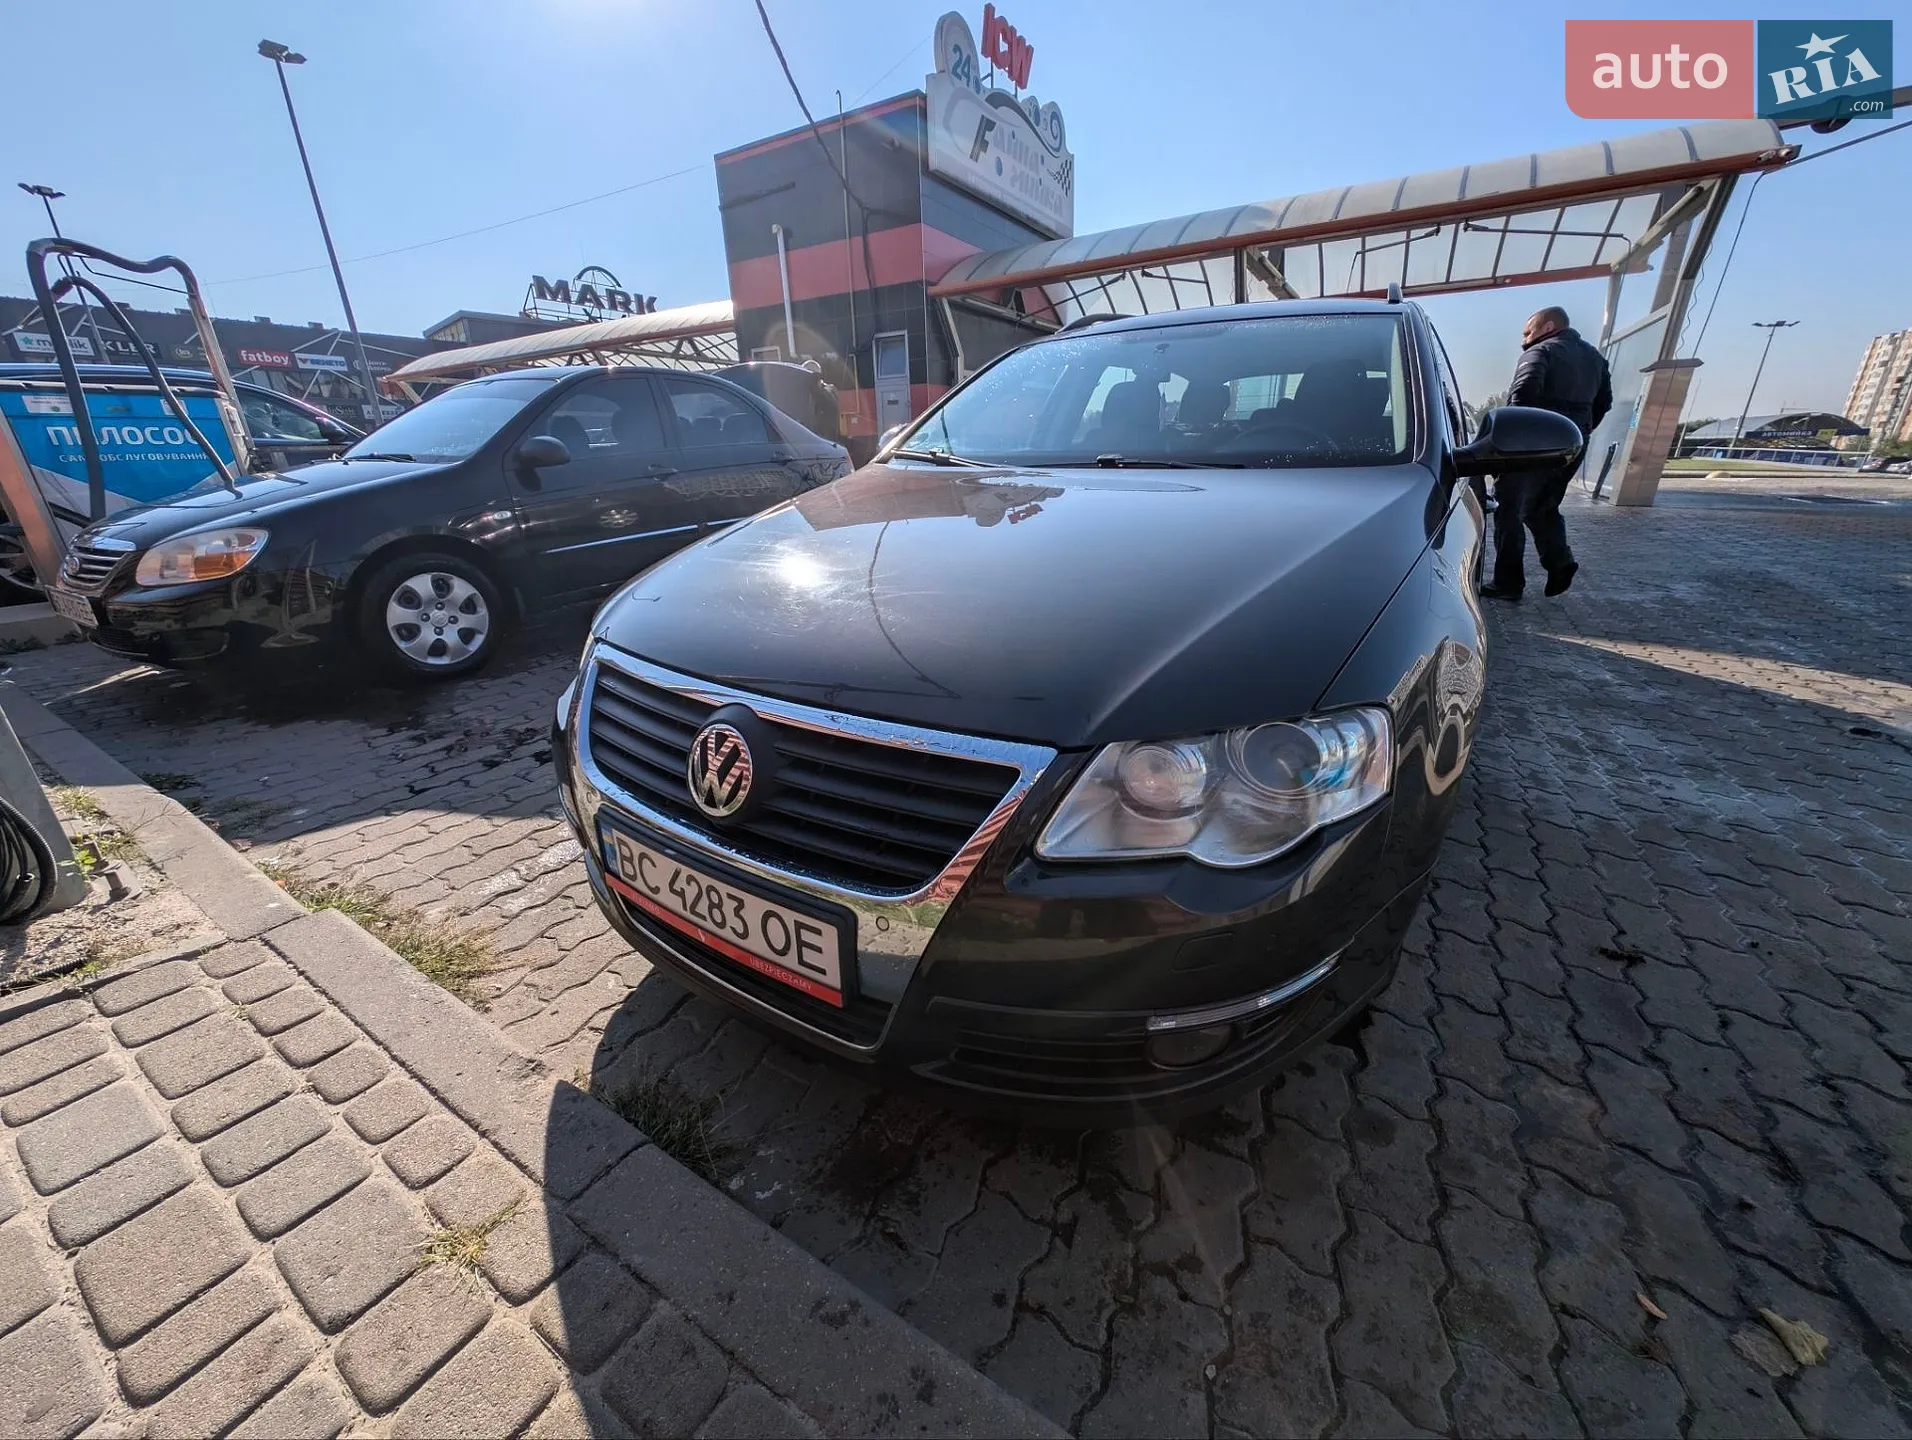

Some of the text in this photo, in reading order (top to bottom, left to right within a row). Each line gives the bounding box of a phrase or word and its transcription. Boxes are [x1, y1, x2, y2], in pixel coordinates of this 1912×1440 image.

[951, 42, 972, 88] 24
[981, 2, 1034, 90] ICW
[240, 349, 289, 365] fatboy
[615, 836, 661, 896] BC
[668, 867, 750, 941] 4283
[760, 909, 828, 977] OE
